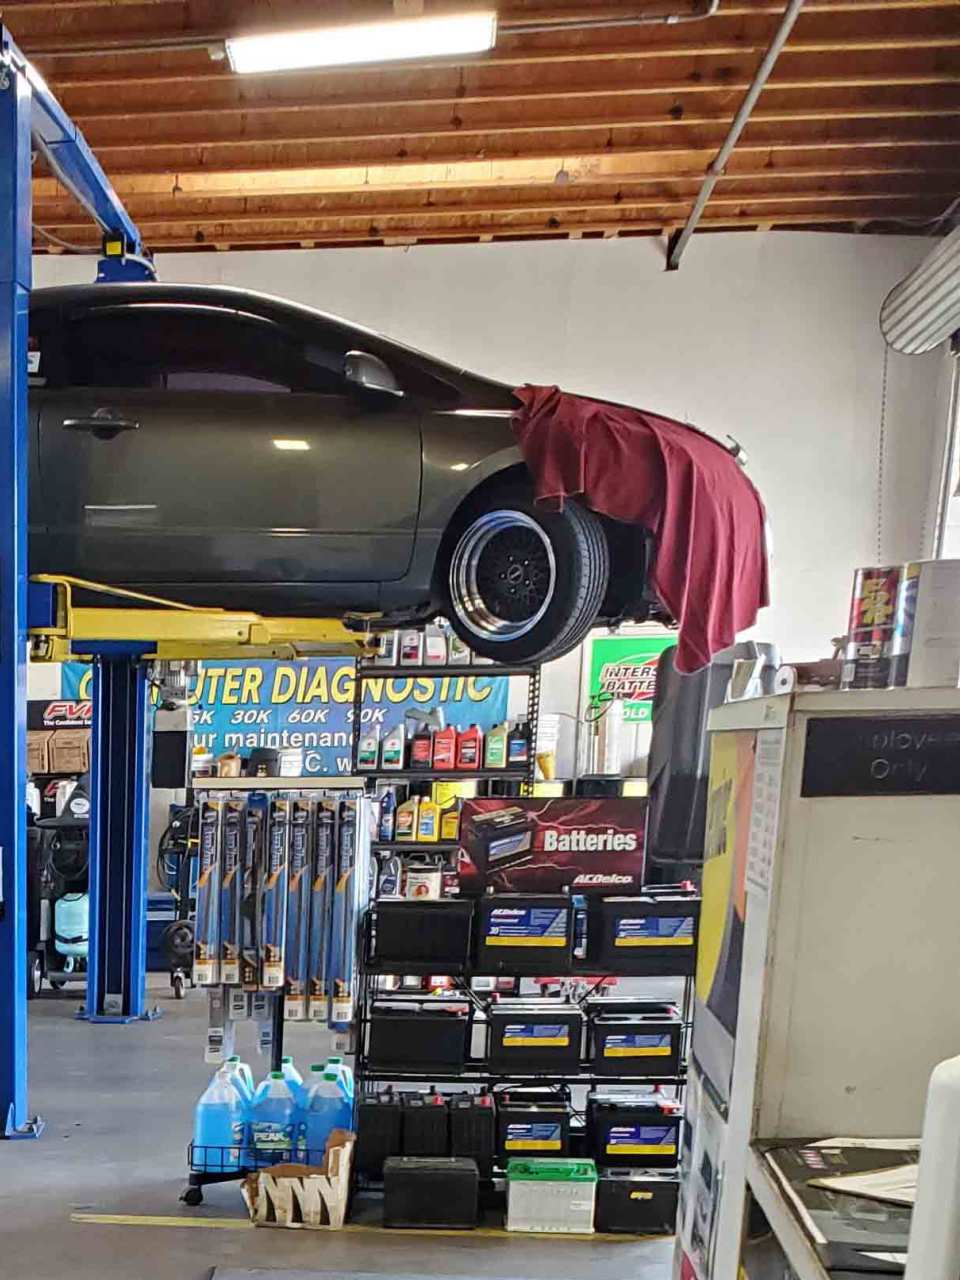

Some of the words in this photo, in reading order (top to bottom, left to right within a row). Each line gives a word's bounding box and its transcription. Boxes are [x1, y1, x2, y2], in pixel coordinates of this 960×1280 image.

[230, 708, 272, 725] 30K
[287, 708, 330, 724] 60K
[223, 727, 354, 749] maintenan
[543, 828, 638, 852] Batteries
[572, 873, 634, 885] ACDelco
